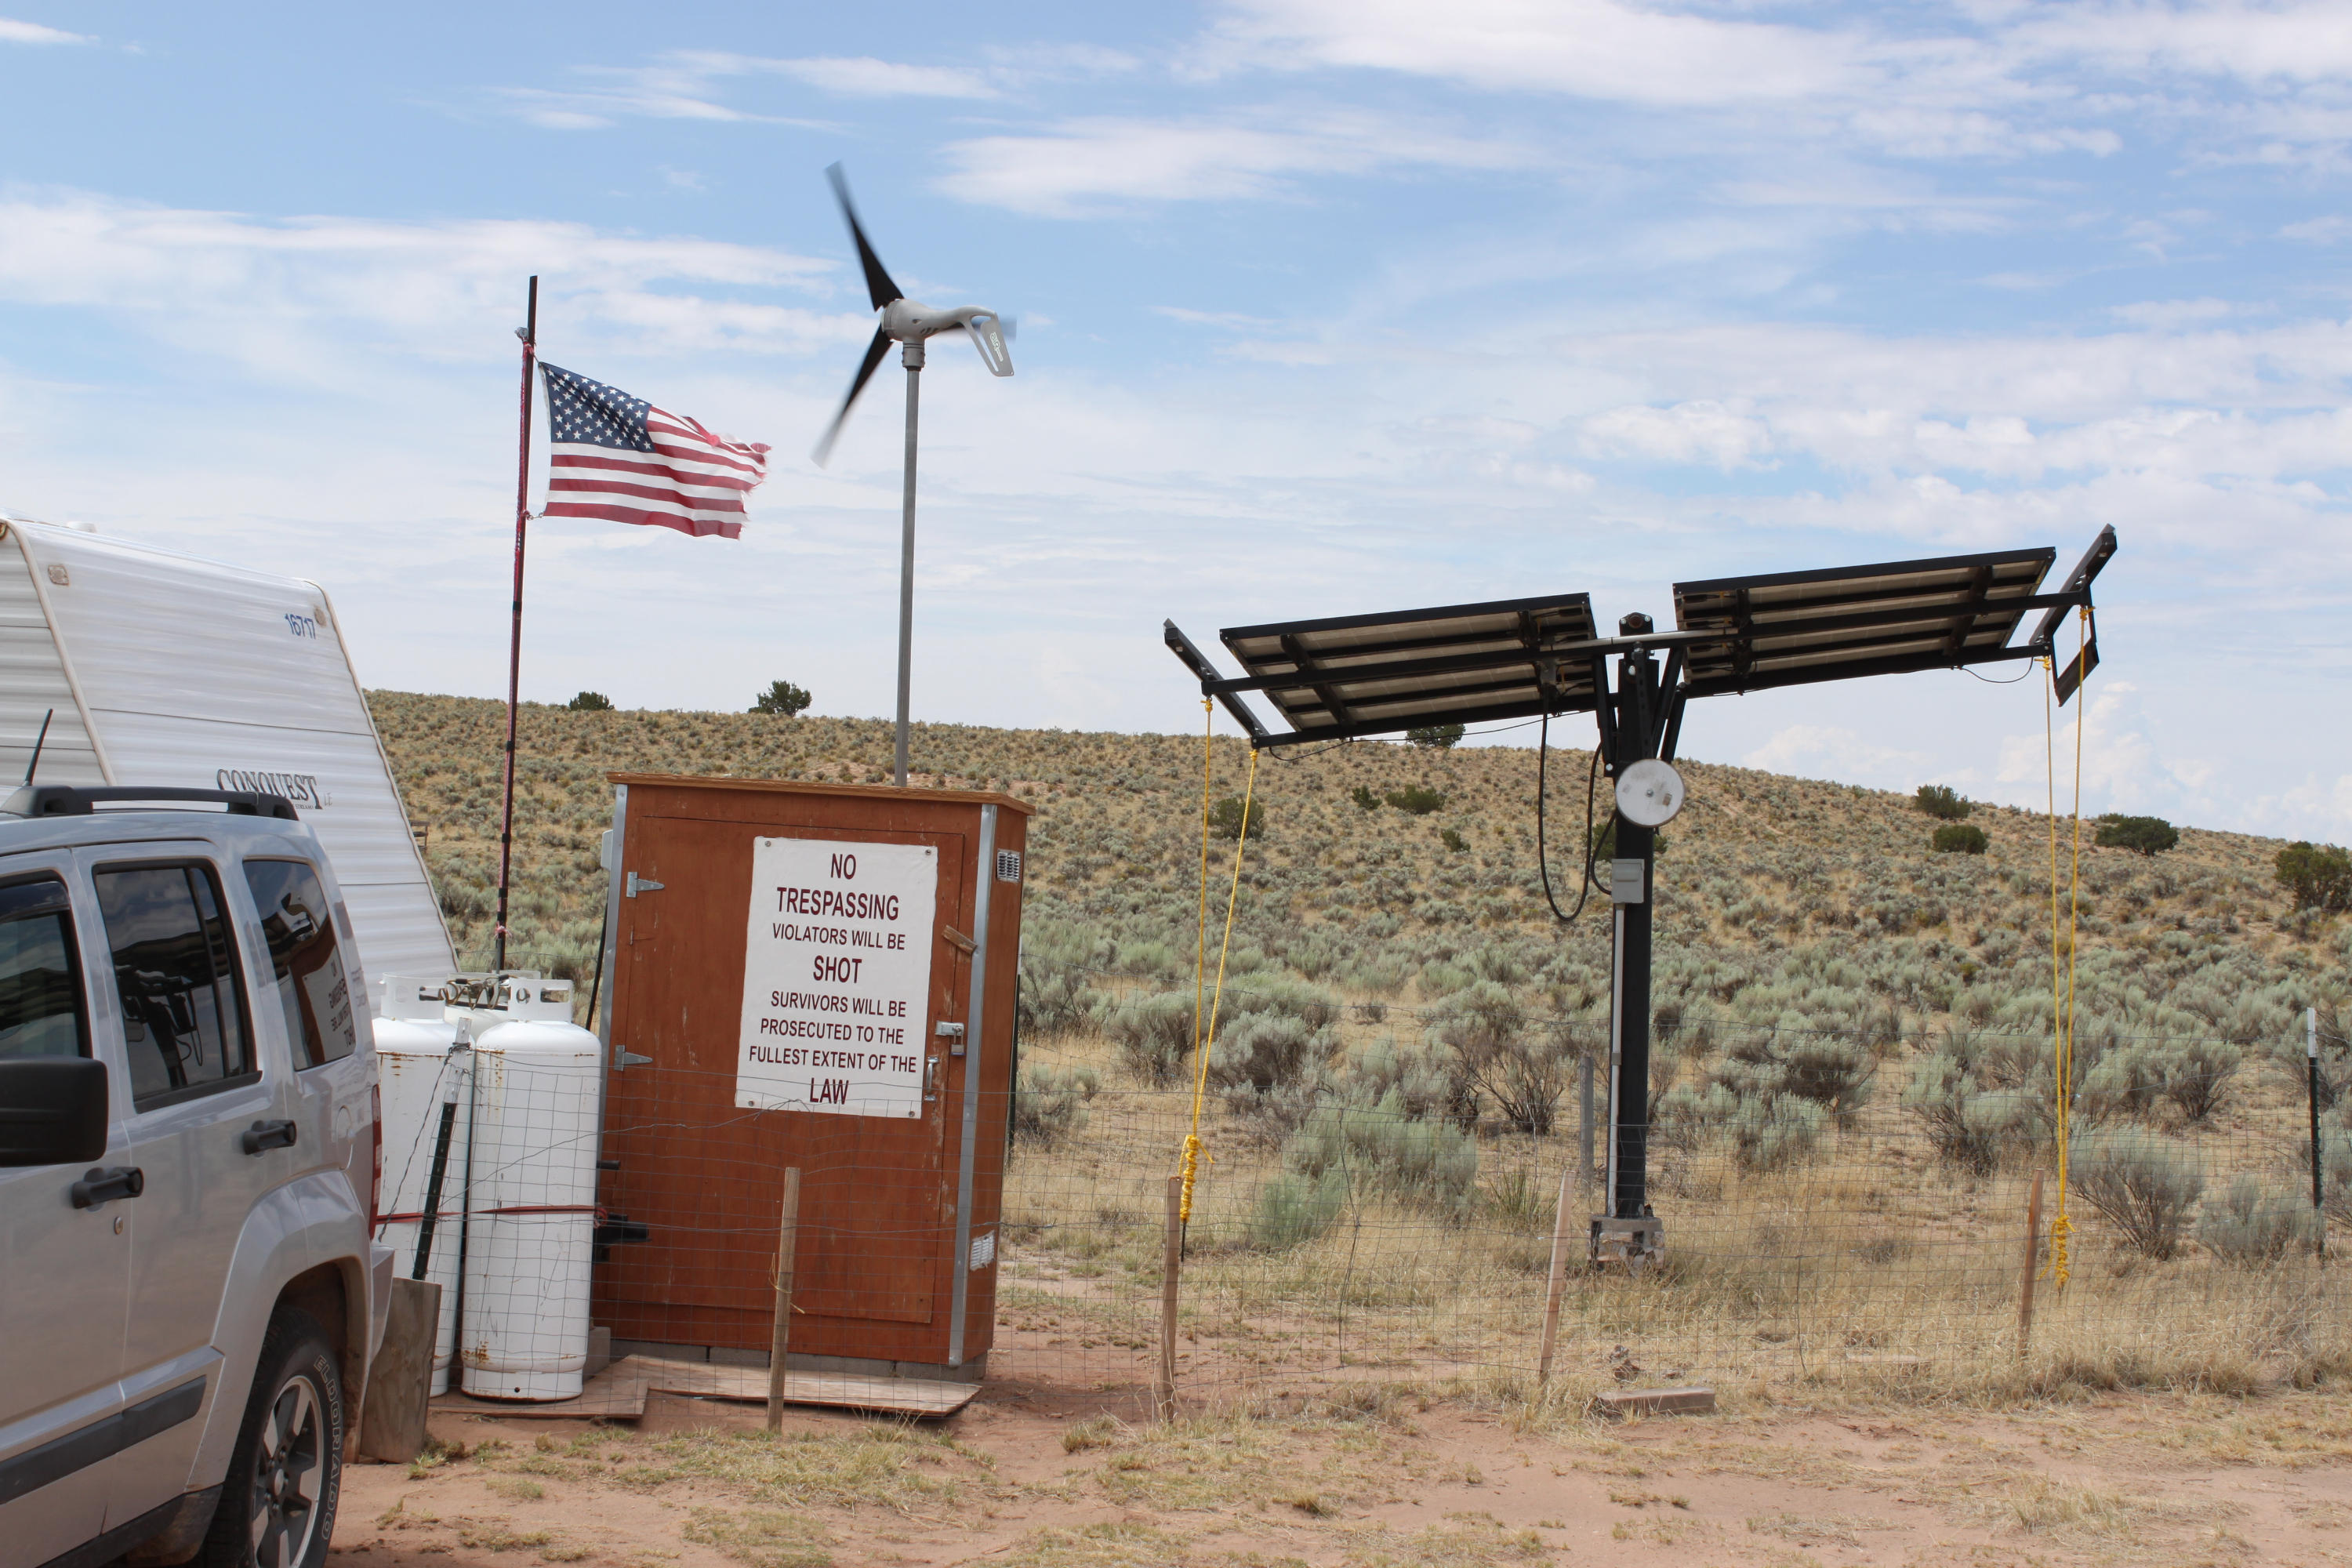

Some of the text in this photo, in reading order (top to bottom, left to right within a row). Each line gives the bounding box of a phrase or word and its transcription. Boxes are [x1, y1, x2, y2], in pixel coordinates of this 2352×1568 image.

[285, 613, 316, 640] 16717
[216, 768, 323, 810] CONQUEST
[830, 853, 857, 880] NO
[777, 887, 899, 920] TRESPASSING
[772, 923, 906, 950] VIOLATORS WILL BE
[813, 955, 862, 984] SHOT
[771, 990, 906, 1018] SURVIVORS WILL BE
[760, 1018, 904, 1045] PROSECUTED TO THE
[749, 1045, 916, 1073] FULLEST EXTENT OF THE
[809, 1077, 849, 1105] LAW
[314, 1354, 342, 1541] ELDORADO
